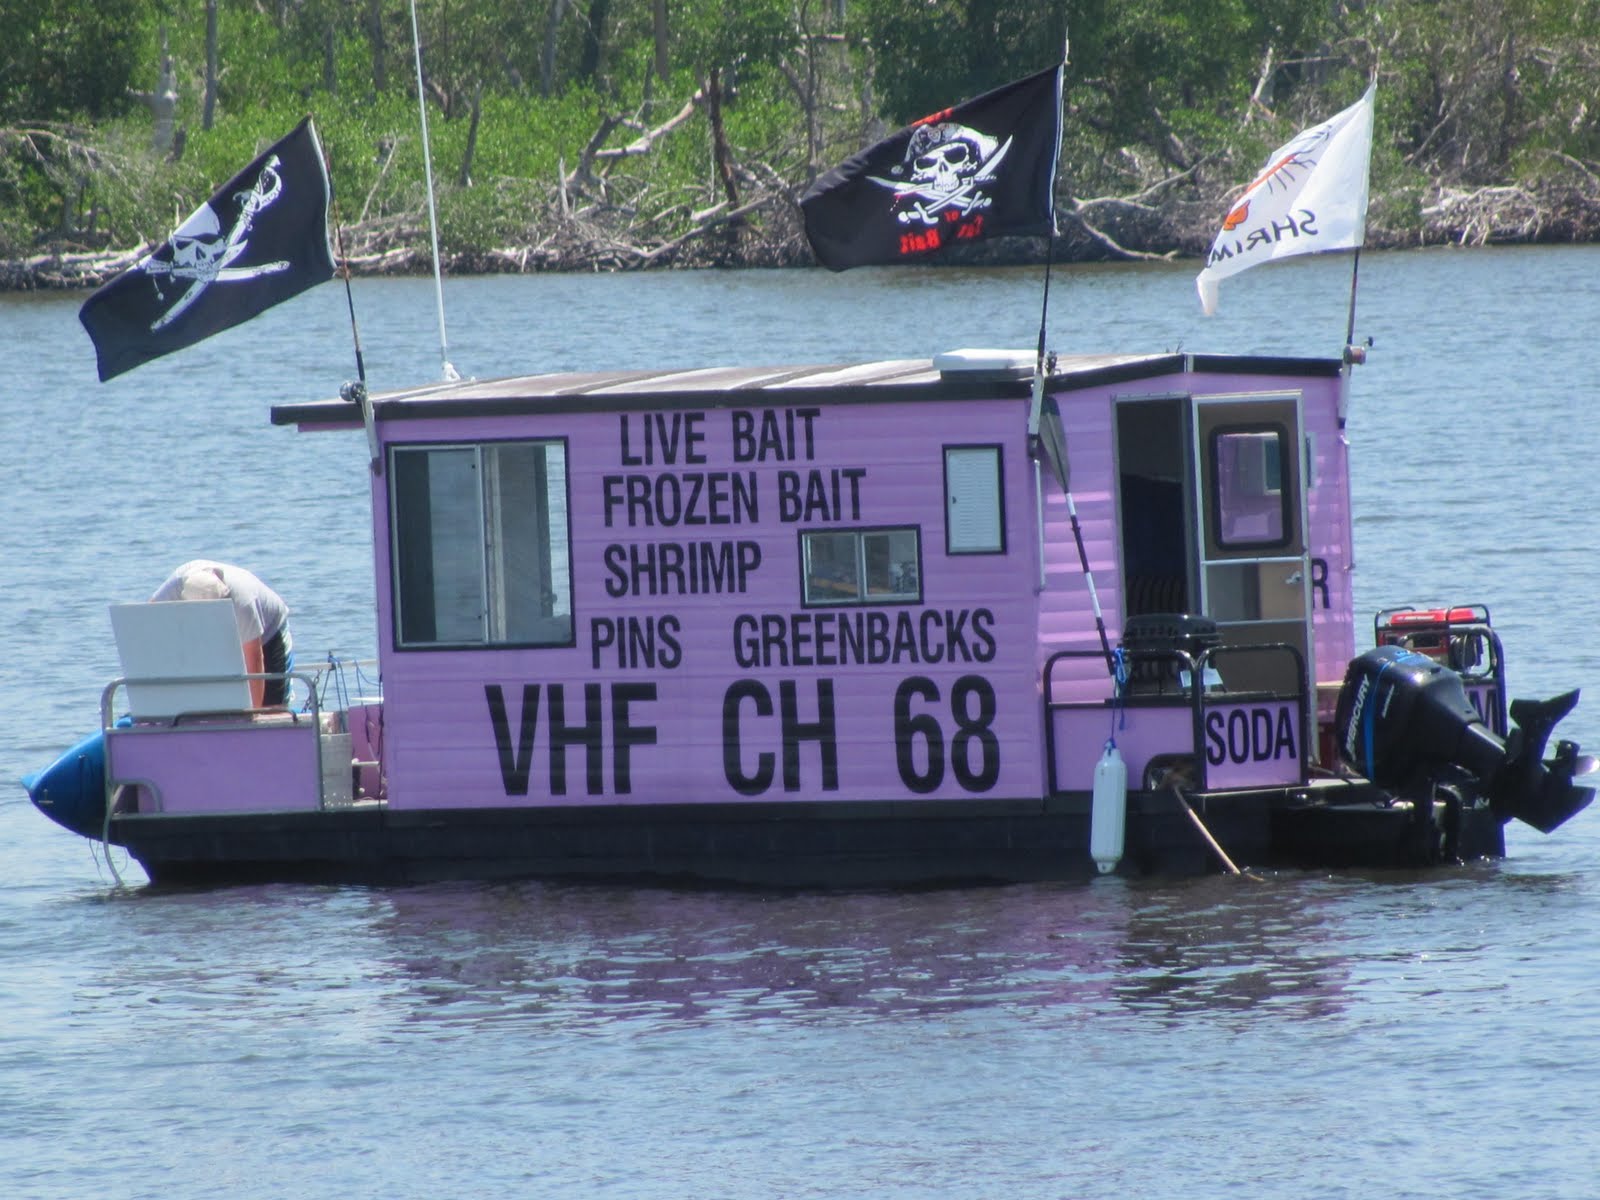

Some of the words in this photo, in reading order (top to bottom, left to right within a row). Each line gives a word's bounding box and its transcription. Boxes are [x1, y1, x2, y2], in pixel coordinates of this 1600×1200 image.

[620, 411, 707, 466] LIVE
[732, 408, 821, 462] BAIT
[603, 472, 759, 527] FROZEN
[778, 468, 866, 522] BAIT
[604, 541, 761, 597] SHRIMP
[591, 615, 682, 669] PINS
[733, 607, 997, 668] GREENBACKS
[484, 682, 657, 796] VHF
[722, 678, 839, 796] CH
[894, 675, 1000, 794] 68
[1206, 707, 1296, 766] SODA
[1346, 673, 1370, 762] MERCURY
